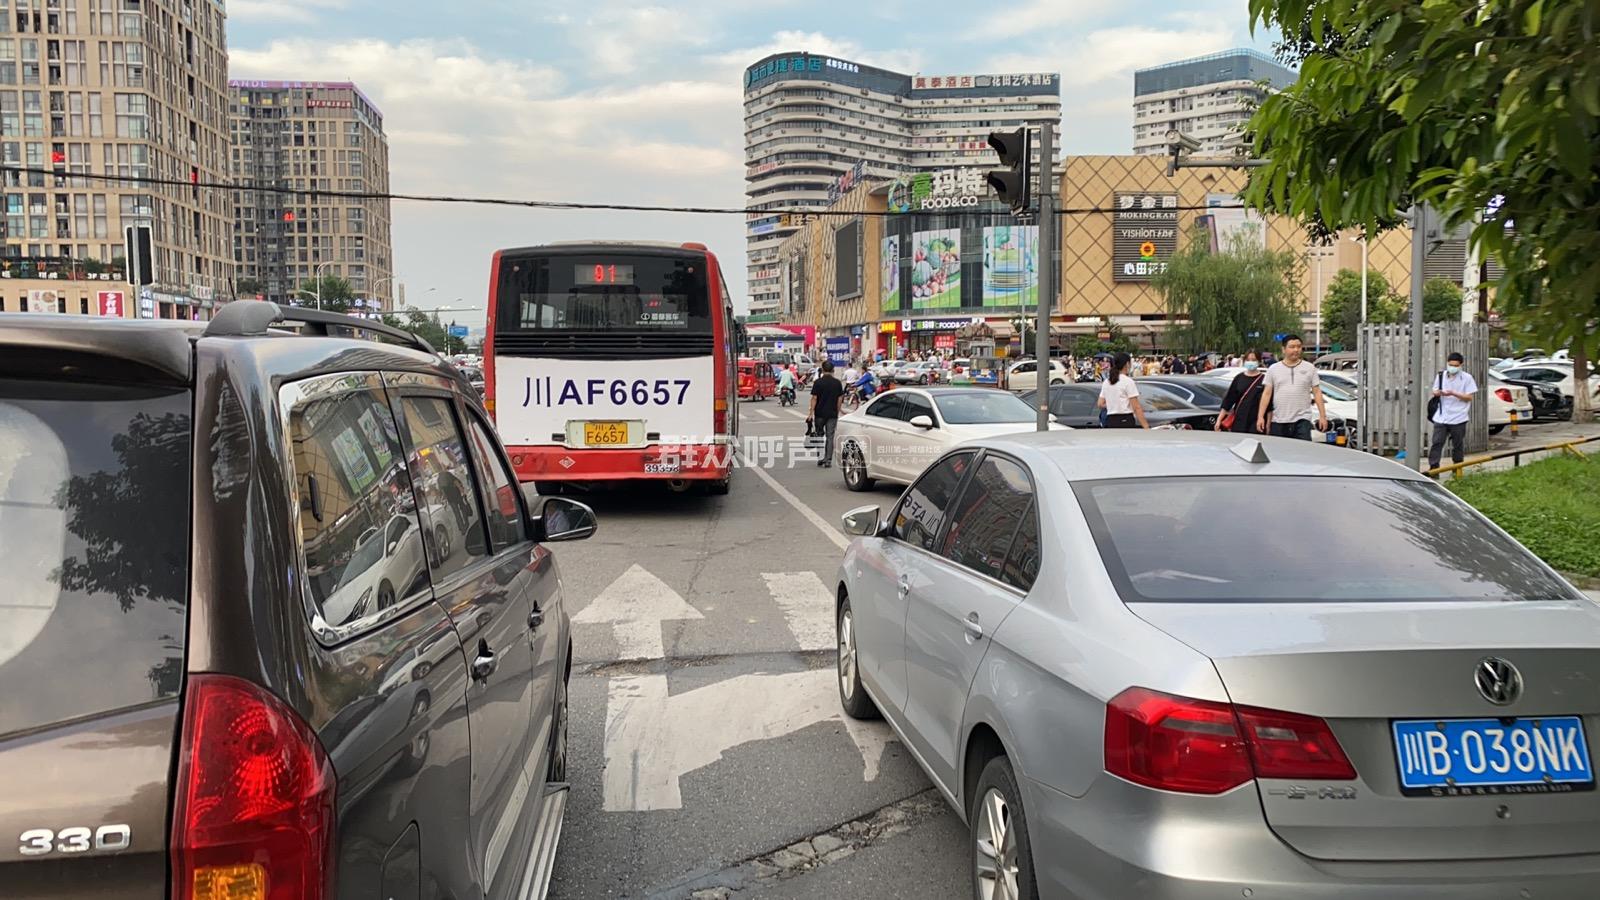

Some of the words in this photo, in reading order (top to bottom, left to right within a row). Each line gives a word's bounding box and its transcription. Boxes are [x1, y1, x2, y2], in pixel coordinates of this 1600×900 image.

[915, 76, 972, 88] 莫泰酒店
[593, 264, 617, 283] 91
[523, 376, 691, 408] 川AF6657
[586, 431, 626, 443] F6657
[1402, 727, 1585, 776] 川B·038NK
[19, 824, 131, 856] 330
